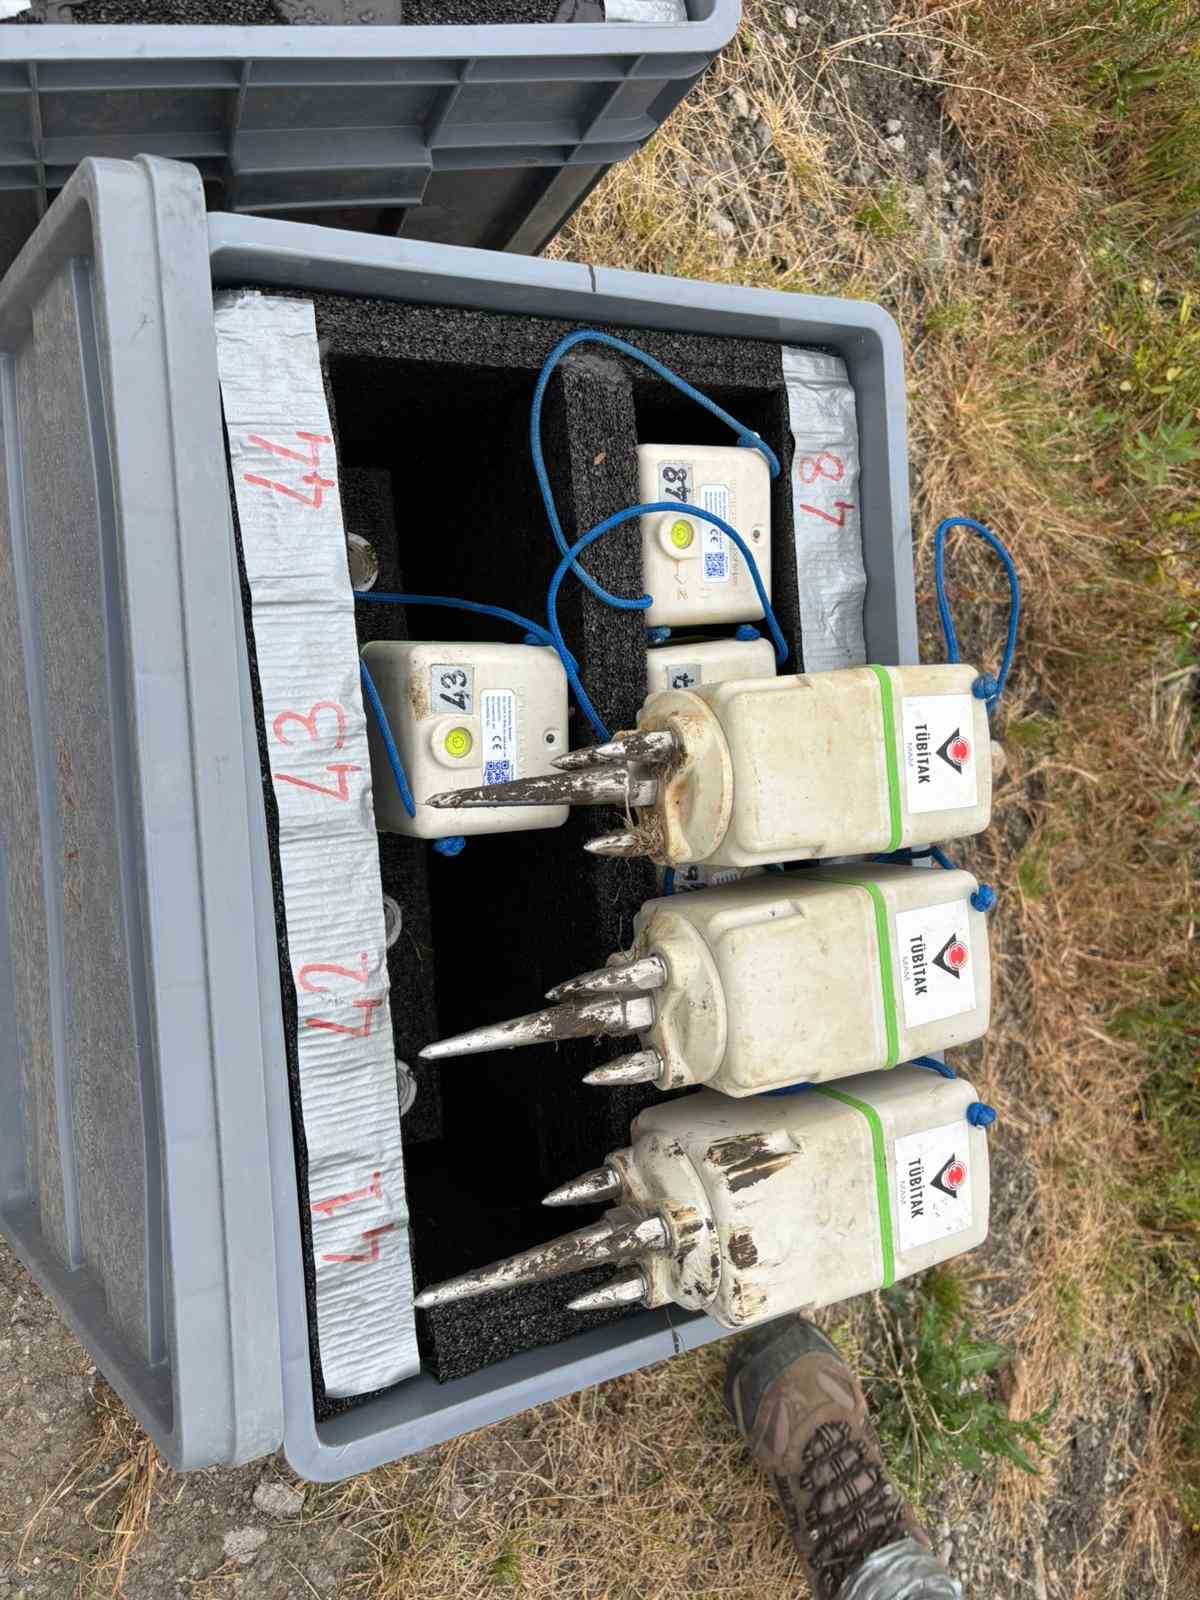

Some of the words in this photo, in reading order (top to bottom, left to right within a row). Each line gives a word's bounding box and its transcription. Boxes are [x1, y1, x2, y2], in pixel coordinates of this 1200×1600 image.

[243, 431, 335, 509] 44
[662, 466, 691, 503] 48
[799, 451, 855, 528] 48
[440, 670, 470, 710] 43
[272, 701, 362, 801] 43
[915, 723, 931, 784] TÜBİTAK
[909, 934, 928, 996] TÜBİTAK
[908, 1157, 925, 1218] TÜBİTAK
